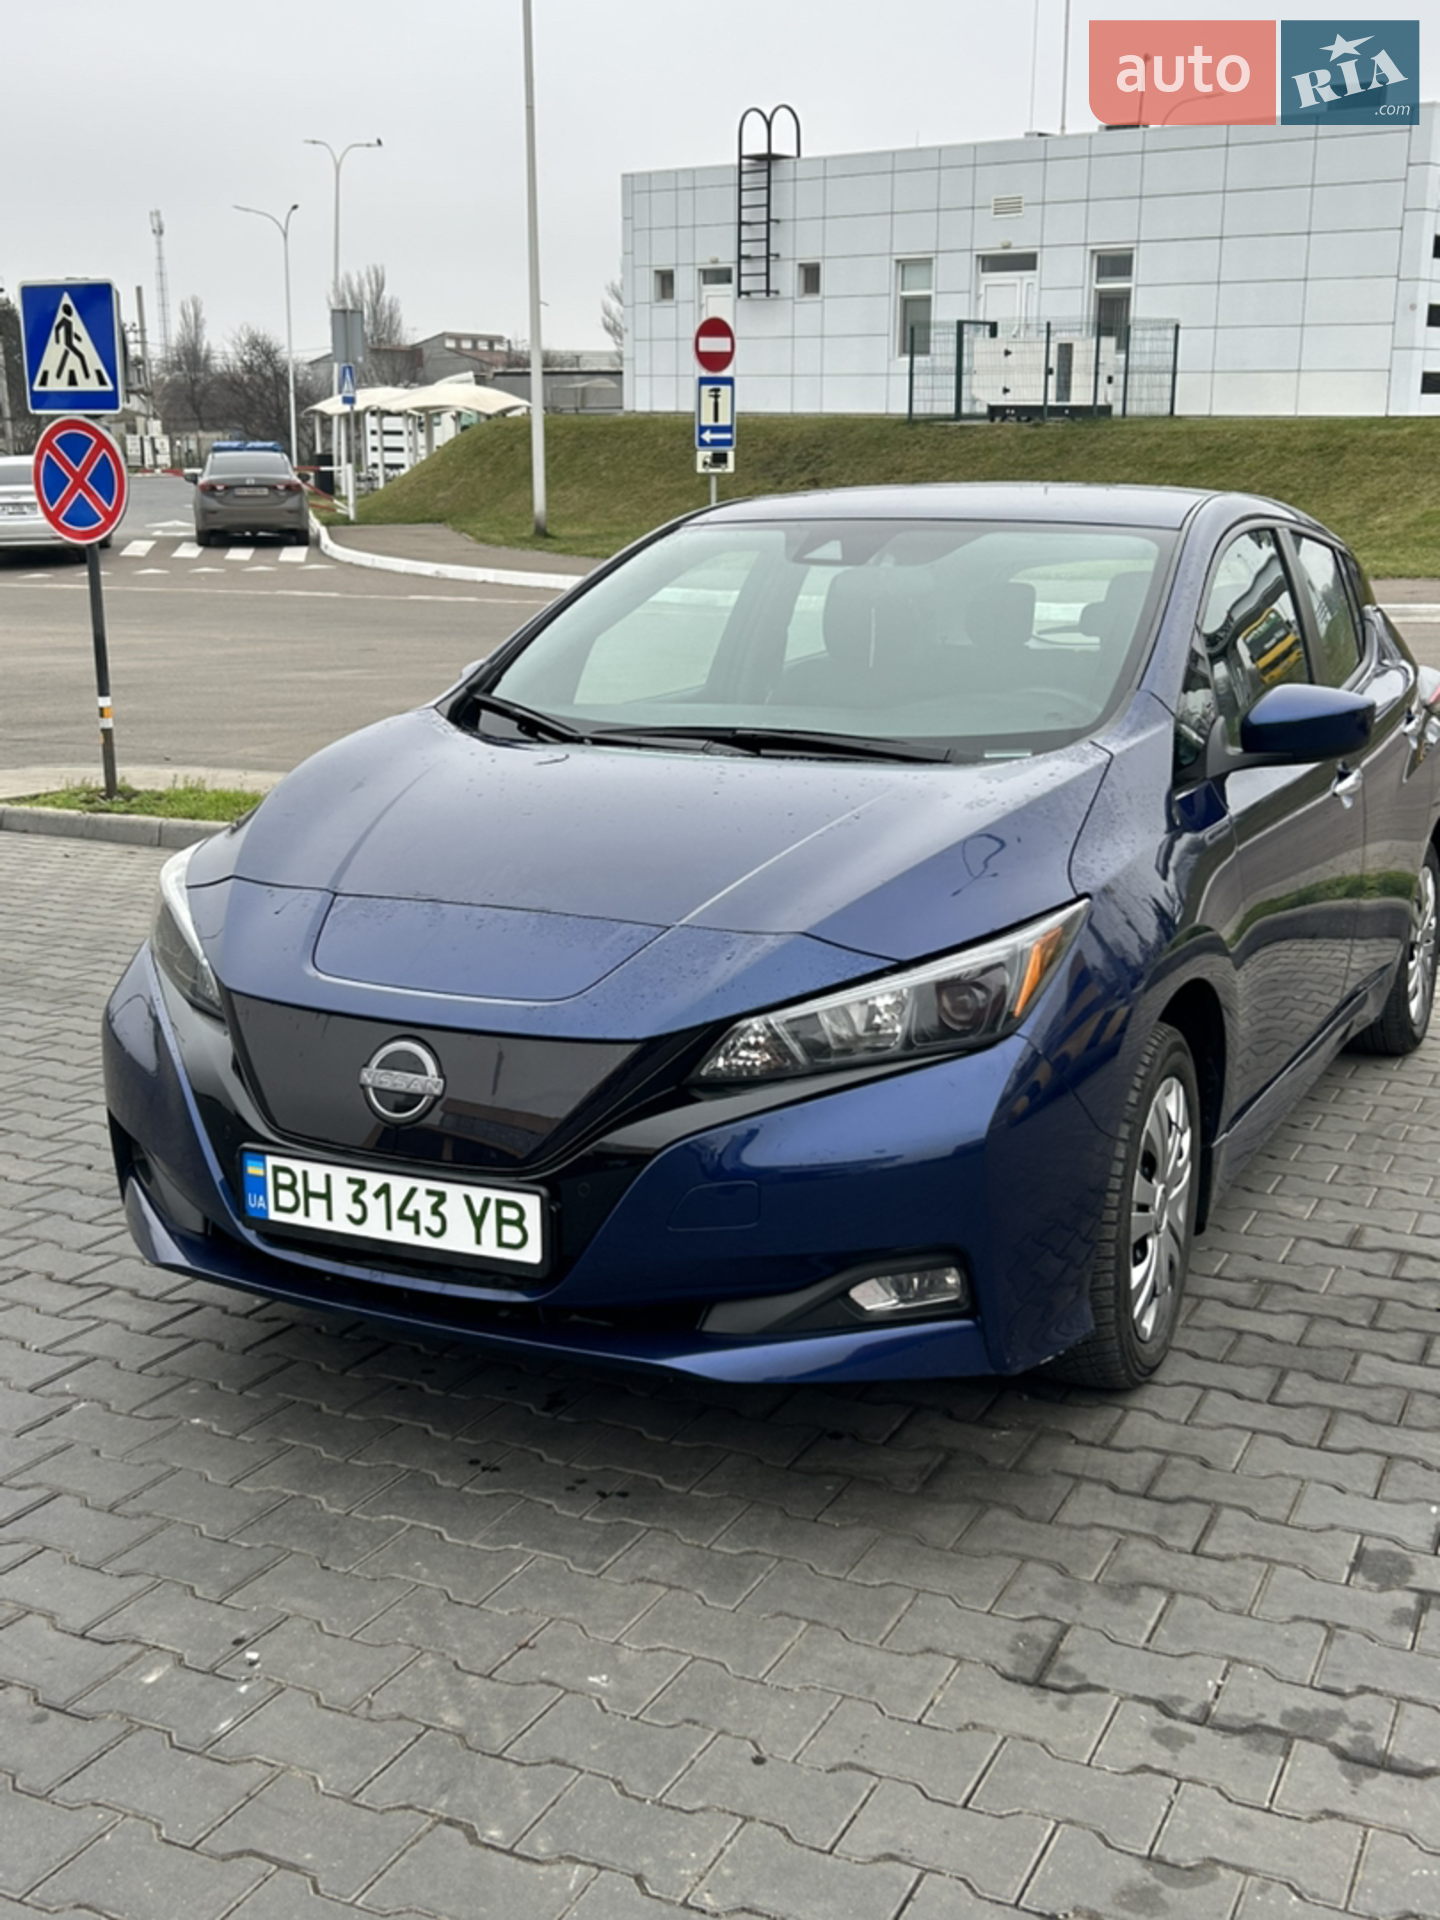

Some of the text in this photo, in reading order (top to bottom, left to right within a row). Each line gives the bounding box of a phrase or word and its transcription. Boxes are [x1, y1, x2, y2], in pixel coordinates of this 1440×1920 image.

[361, 1068, 444, 1095] NISSAN
[248, 1193, 267, 1210] UA
[271, 1164, 529, 1250] BH 3143 YB
